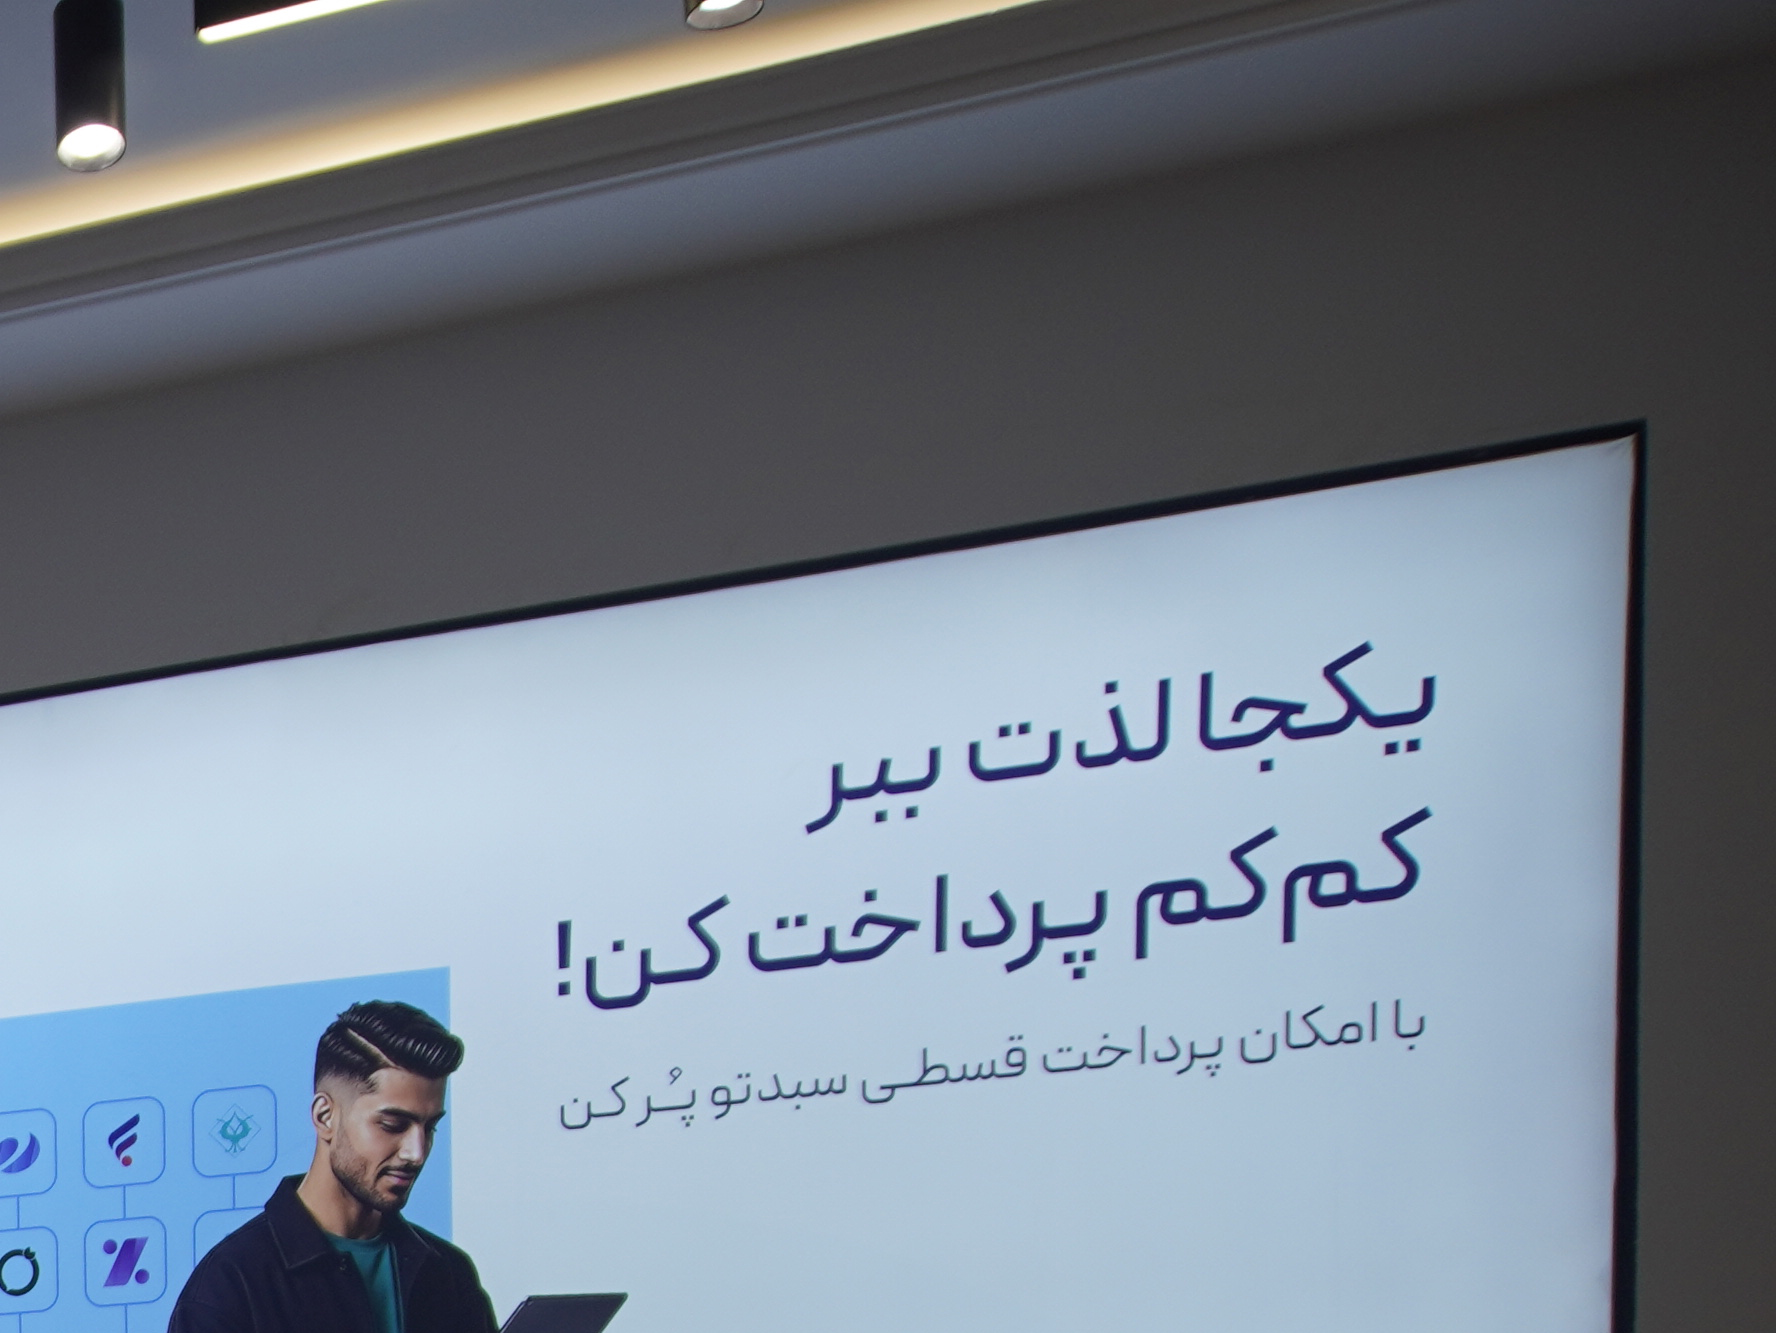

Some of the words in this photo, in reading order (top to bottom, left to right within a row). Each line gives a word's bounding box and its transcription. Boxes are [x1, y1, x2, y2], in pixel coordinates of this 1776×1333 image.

[966, 676, 1171, 783] لذت
[1198, 638, 1438, 770] یکجا
[804, 744, 942, 834] ببر
[747, 873, 1109, 983] پرداخت
[859, 1035, 1028, 1108] قسطی
[1041, 1026, 1225, 1083] پرداخت
[1238, 1000, 1380, 1069] امکان
[557, 1078, 629, 1132] کن
